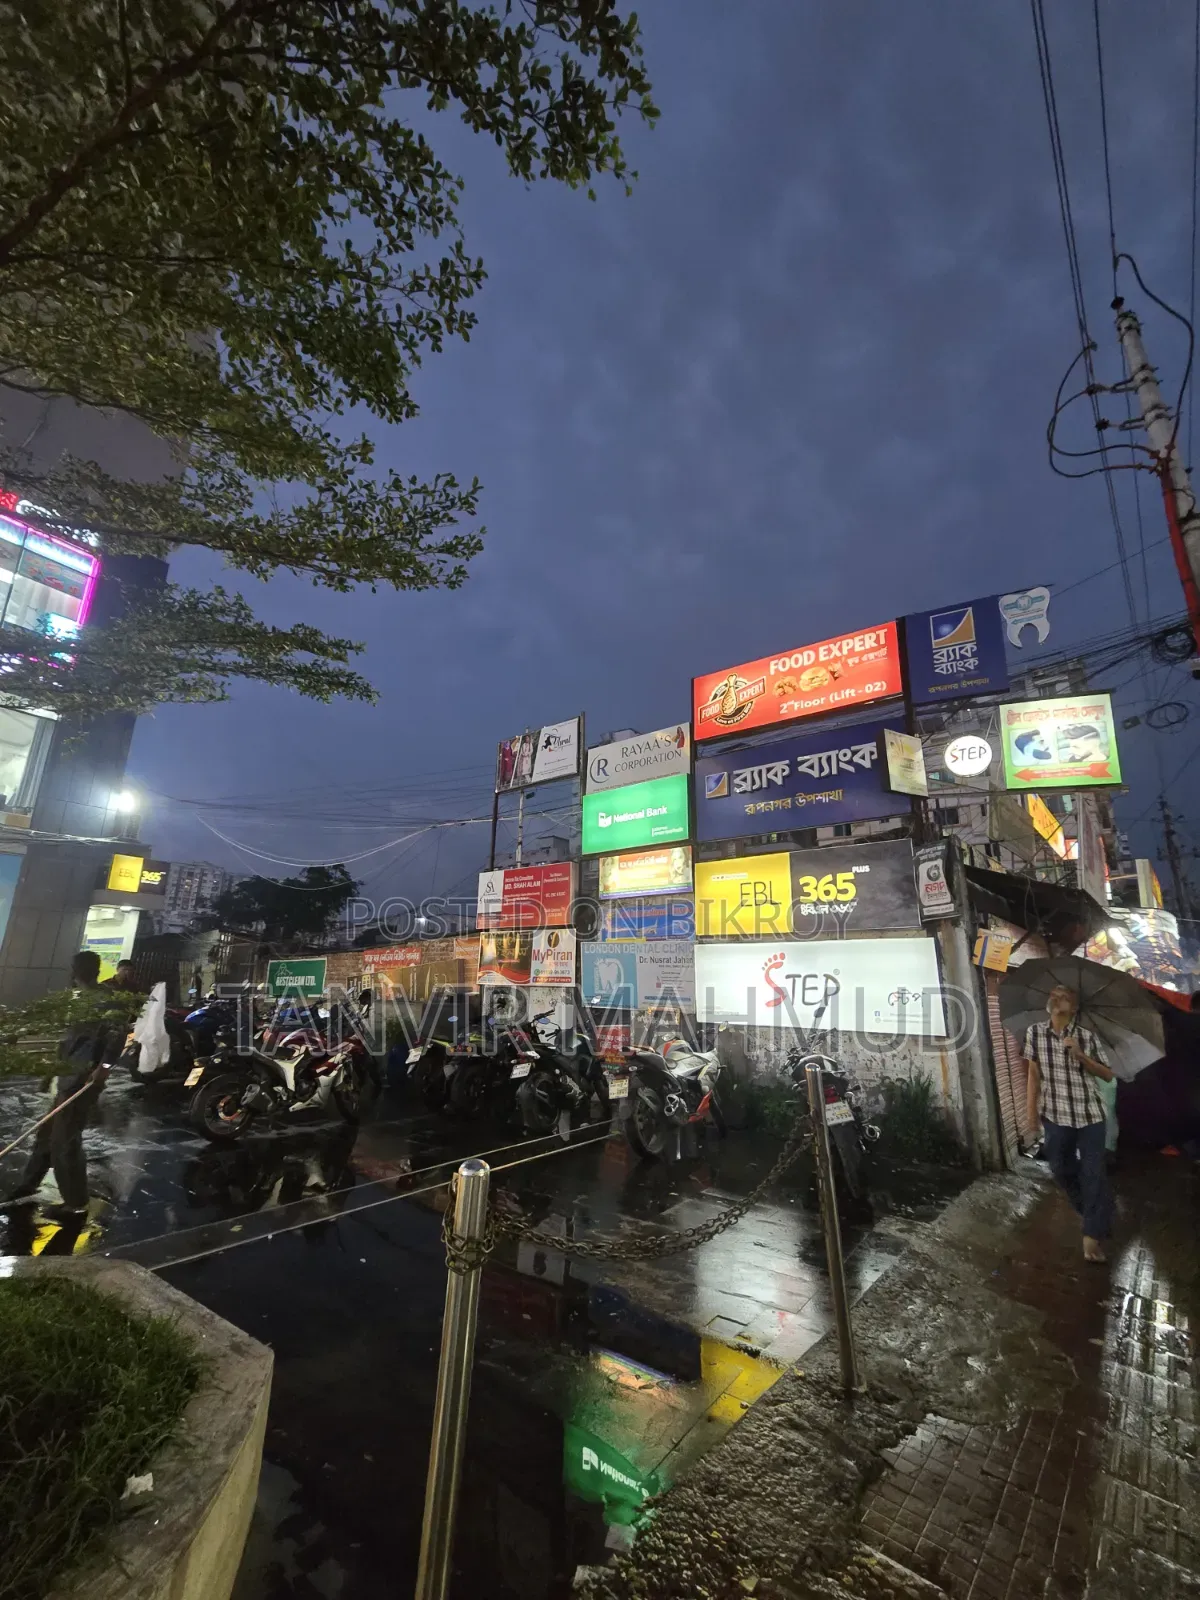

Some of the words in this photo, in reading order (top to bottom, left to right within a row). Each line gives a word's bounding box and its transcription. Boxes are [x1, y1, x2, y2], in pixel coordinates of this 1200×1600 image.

[769, 649, 816, 675] FOOD
[818, 628, 888, 662] EXPERT
[933, 657, 979, 675] ব্যাংক
[701, 703, 720, 719] FOOD
[740, 682, 764, 701] EXPERT
[621, 735, 672, 758] RAYAA'S
[950, 745, 987, 763] STEP
[614, 749, 682, 773] CORPORATION
[733, 760, 790, 794] ব্র্যাক
[797, 742, 878, 778] ব্যাংক
[796, 788, 844, 807] উপশাখা
[613, 810, 645, 823] National
[646, 806, 668, 818] Bank
[141, 870, 162, 881] 365
[851, 865, 870, 873] PLUS
[740, 881, 782, 907] EBL
[798, 872, 857, 903] 365
[532, 949, 573, 964] MyPiran
[584, 943, 621, 954] LONDON
[623, 943, 660, 954] DENTAL
[639, 955, 648, 964] Dr.
[649, 955, 674, 964] Nusrat
[674, 955, 694, 964] Jahan
[304, 975, 316, 986] LTD.
[763, 953, 841, 1008] STEP
